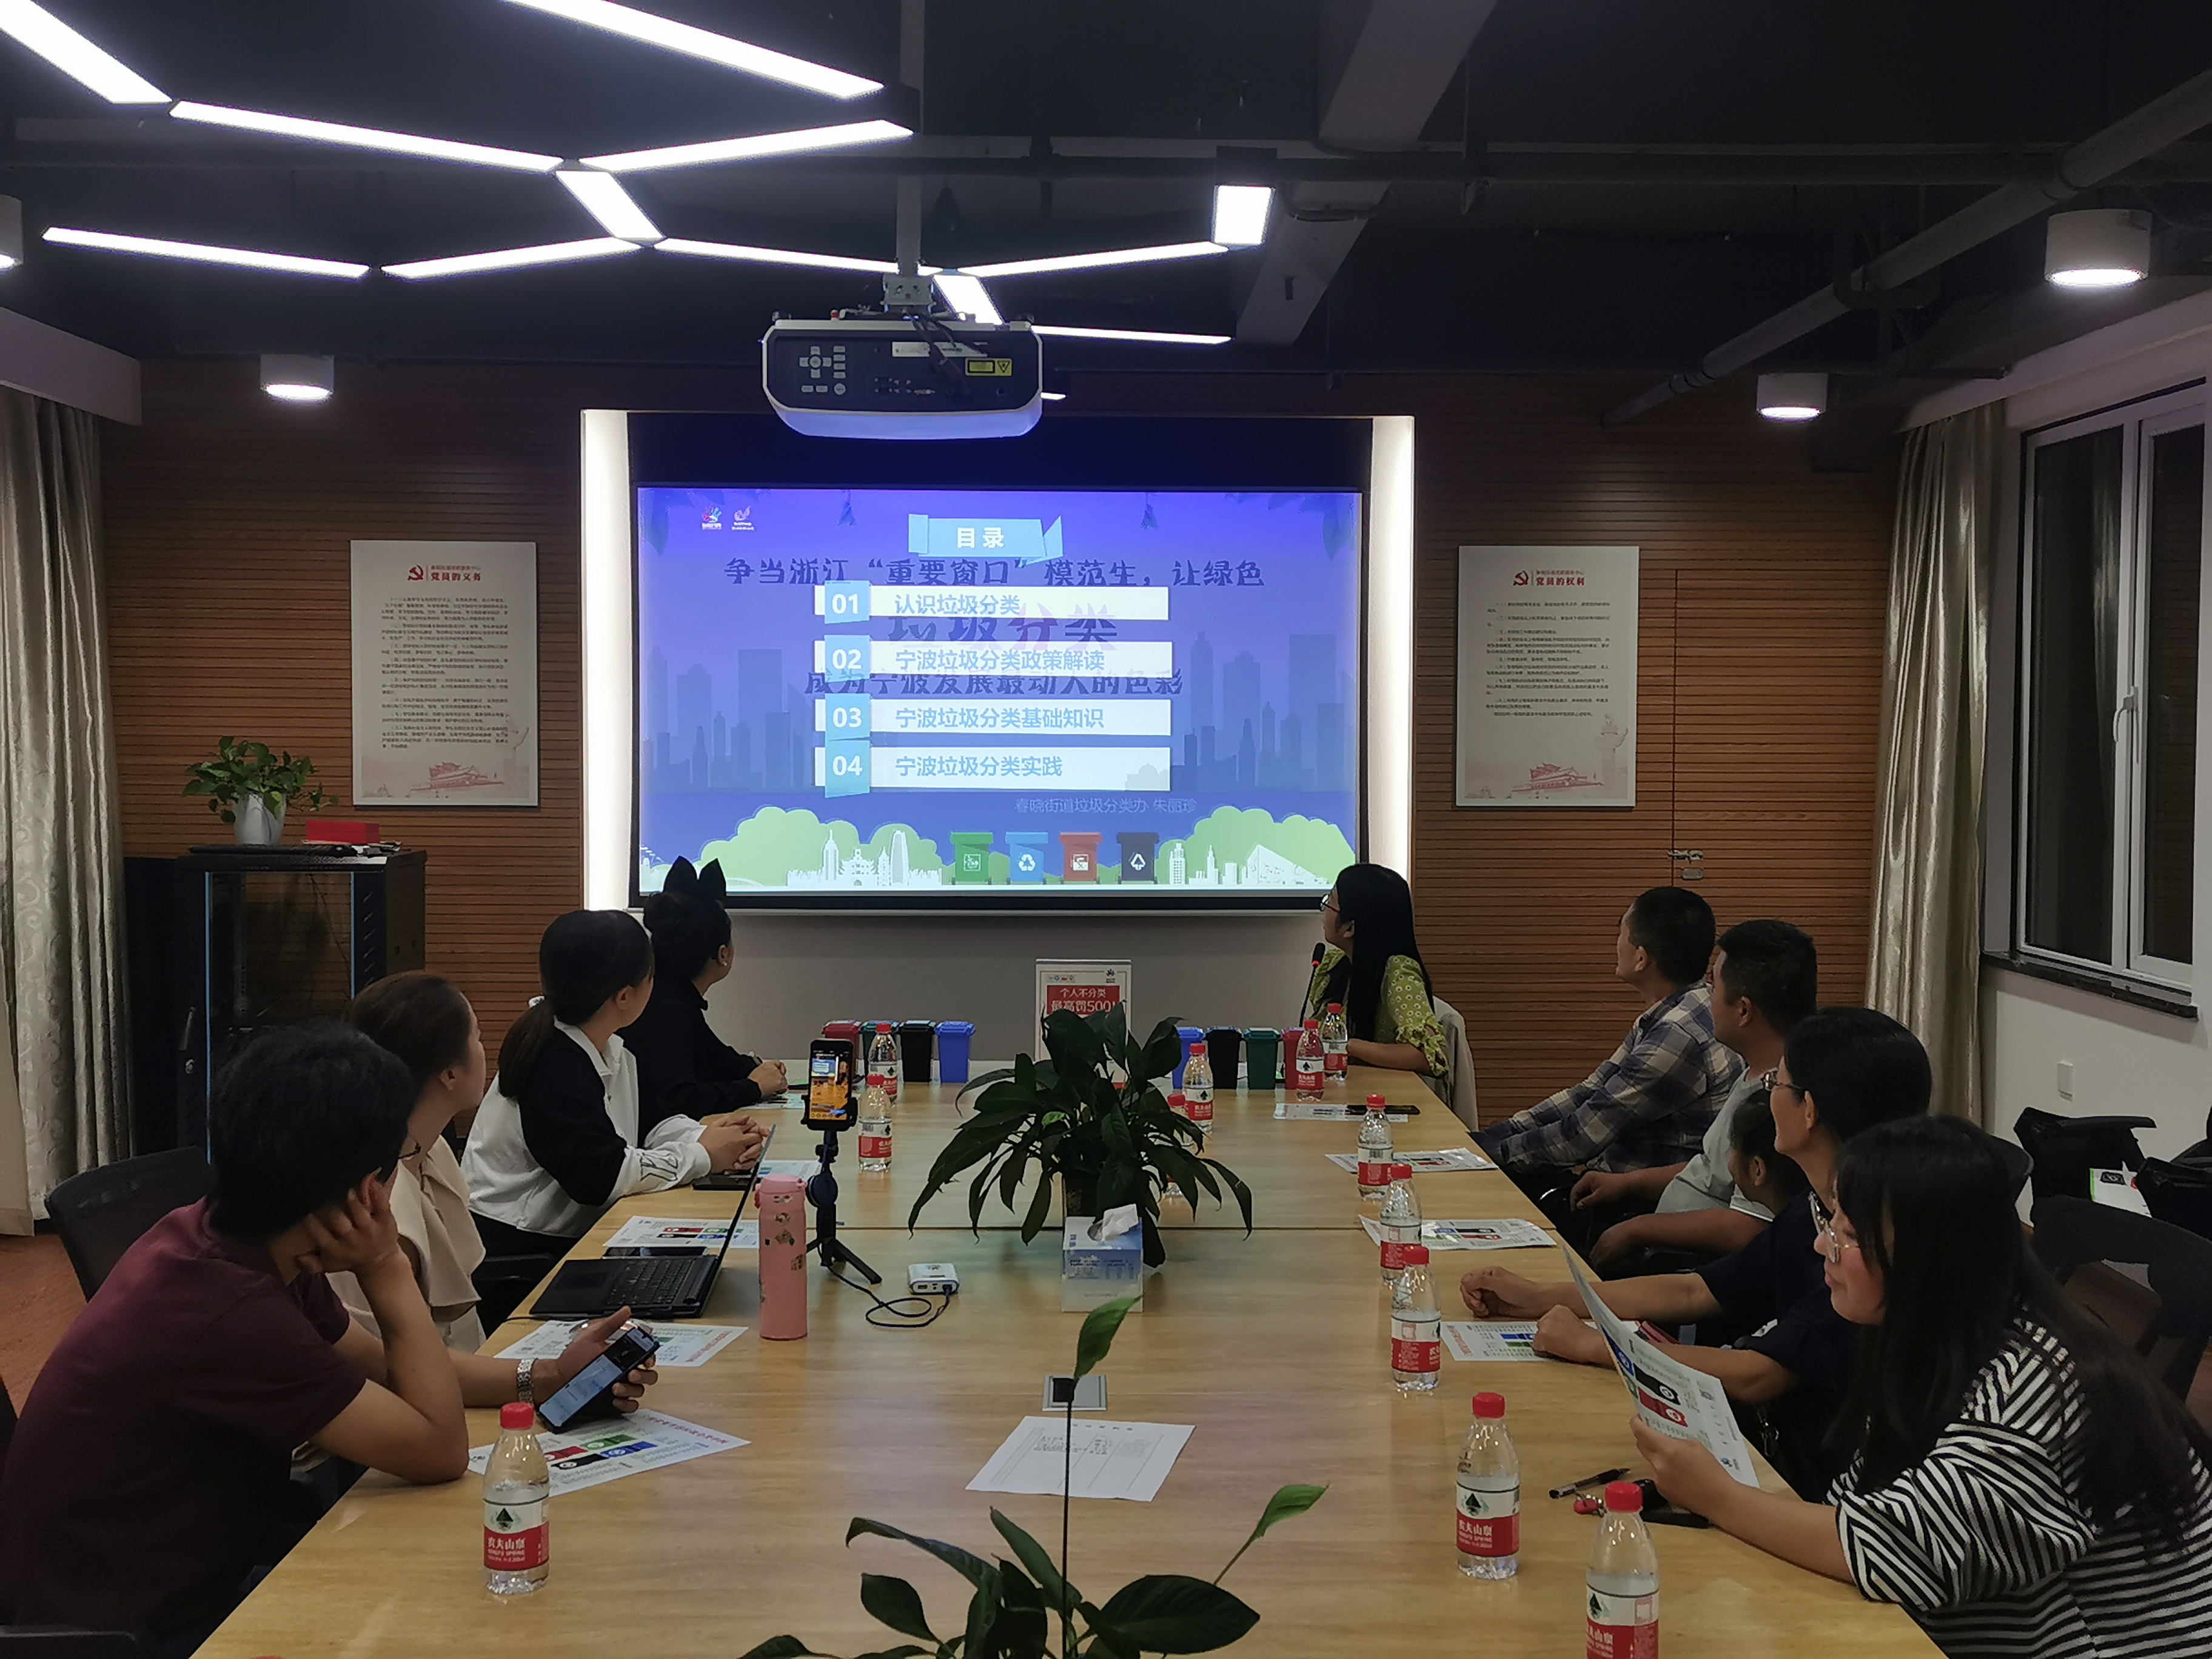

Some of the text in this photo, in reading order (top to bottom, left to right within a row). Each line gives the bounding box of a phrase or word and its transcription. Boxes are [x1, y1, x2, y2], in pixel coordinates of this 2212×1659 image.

[956, 527, 1005, 548] 目录
[431, 572, 481, 581] 党员的义务
[1536, 577, 1585, 586] 党员的权利
[831, 594, 859, 614] 01
[895, 594, 1021, 615] 认识垃圾分类
[832, 649, 862, 669] 02
[895, 649, 1105, 671] 宁波垃圾分类政策解读
[832, 708, 862, 728] 03
[895, 707, 1105, 729] 宁波垃圾分类基础知识
[832, 755, 863, 776] 04
[895, 755, 1063, 777] 宁波垃圾分类实践
[1060, 988, 1106, 998] 个人不分类
